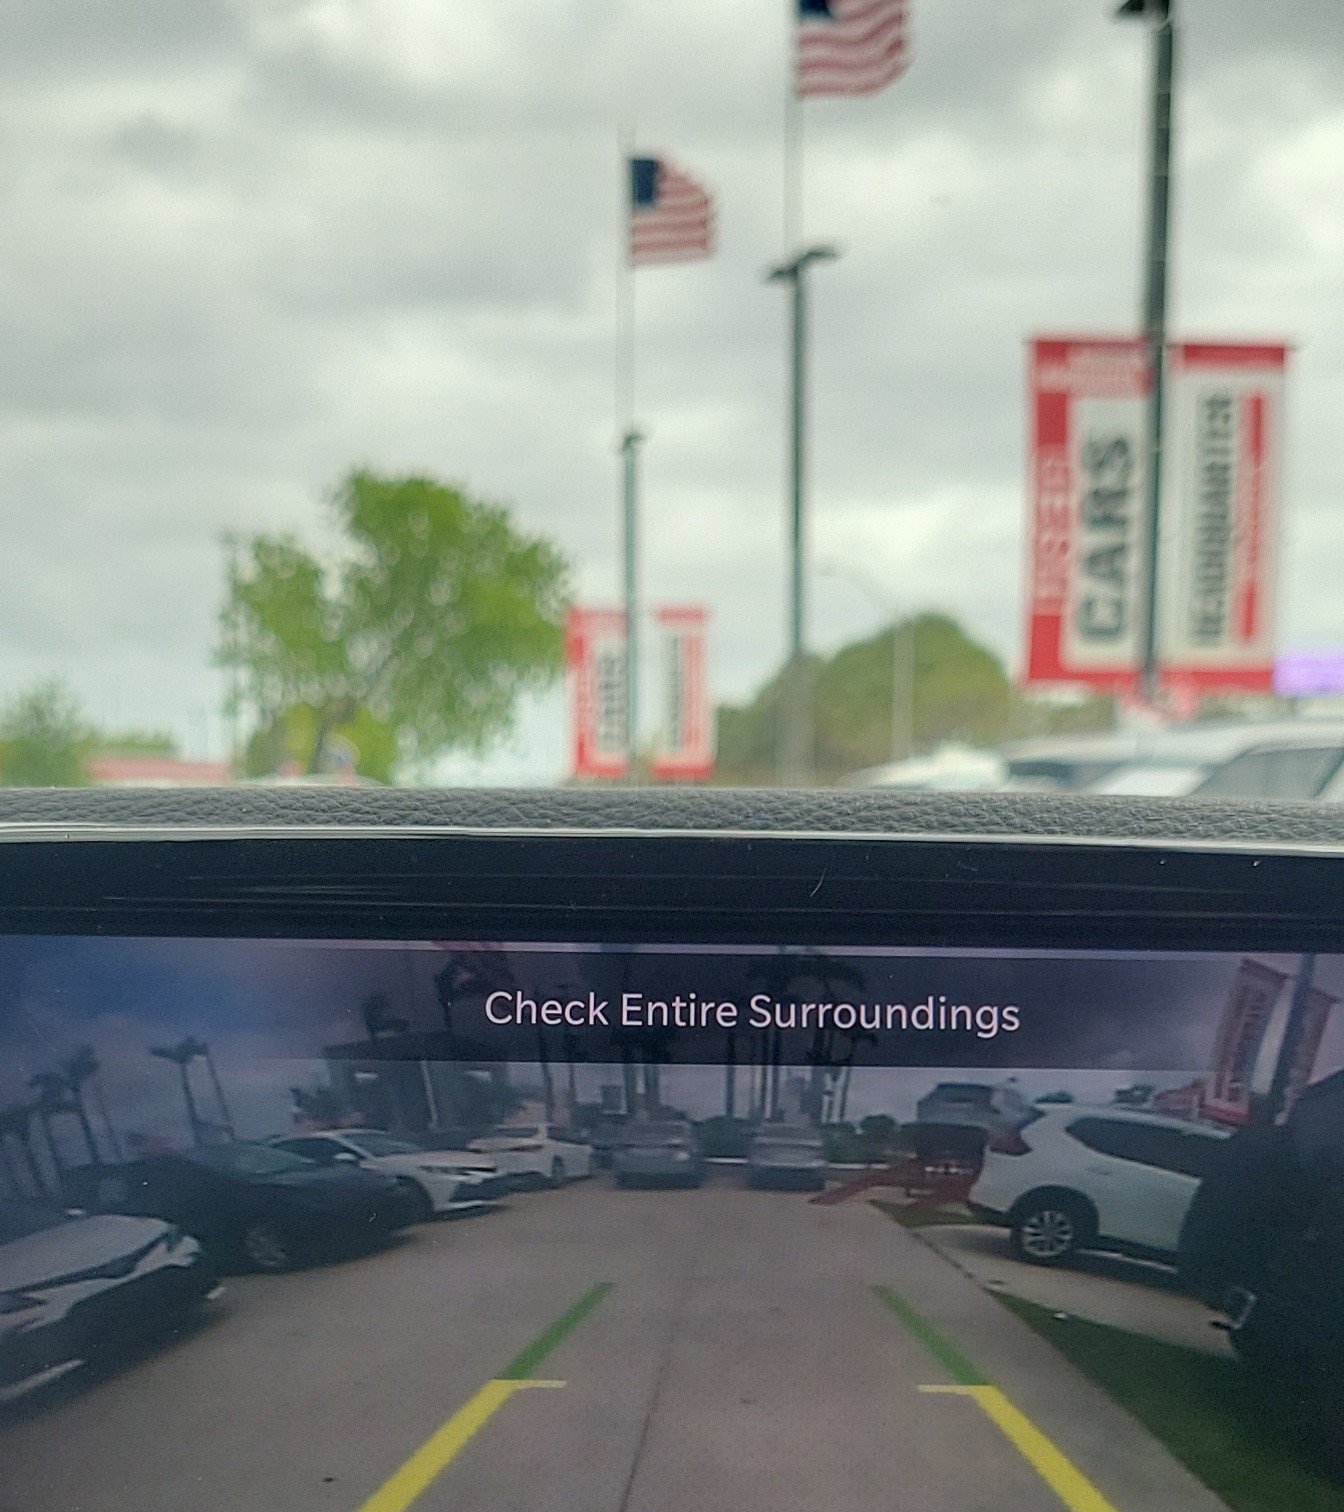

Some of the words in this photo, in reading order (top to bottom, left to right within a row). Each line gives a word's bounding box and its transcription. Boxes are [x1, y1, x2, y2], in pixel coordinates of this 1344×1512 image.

[1074, 435, 1133, 645] CARS
[484, 990, 609, 1027] Check
[621, 992, 738, 1029] Entire
[748, 995, 1021, 1039] Surroundings
